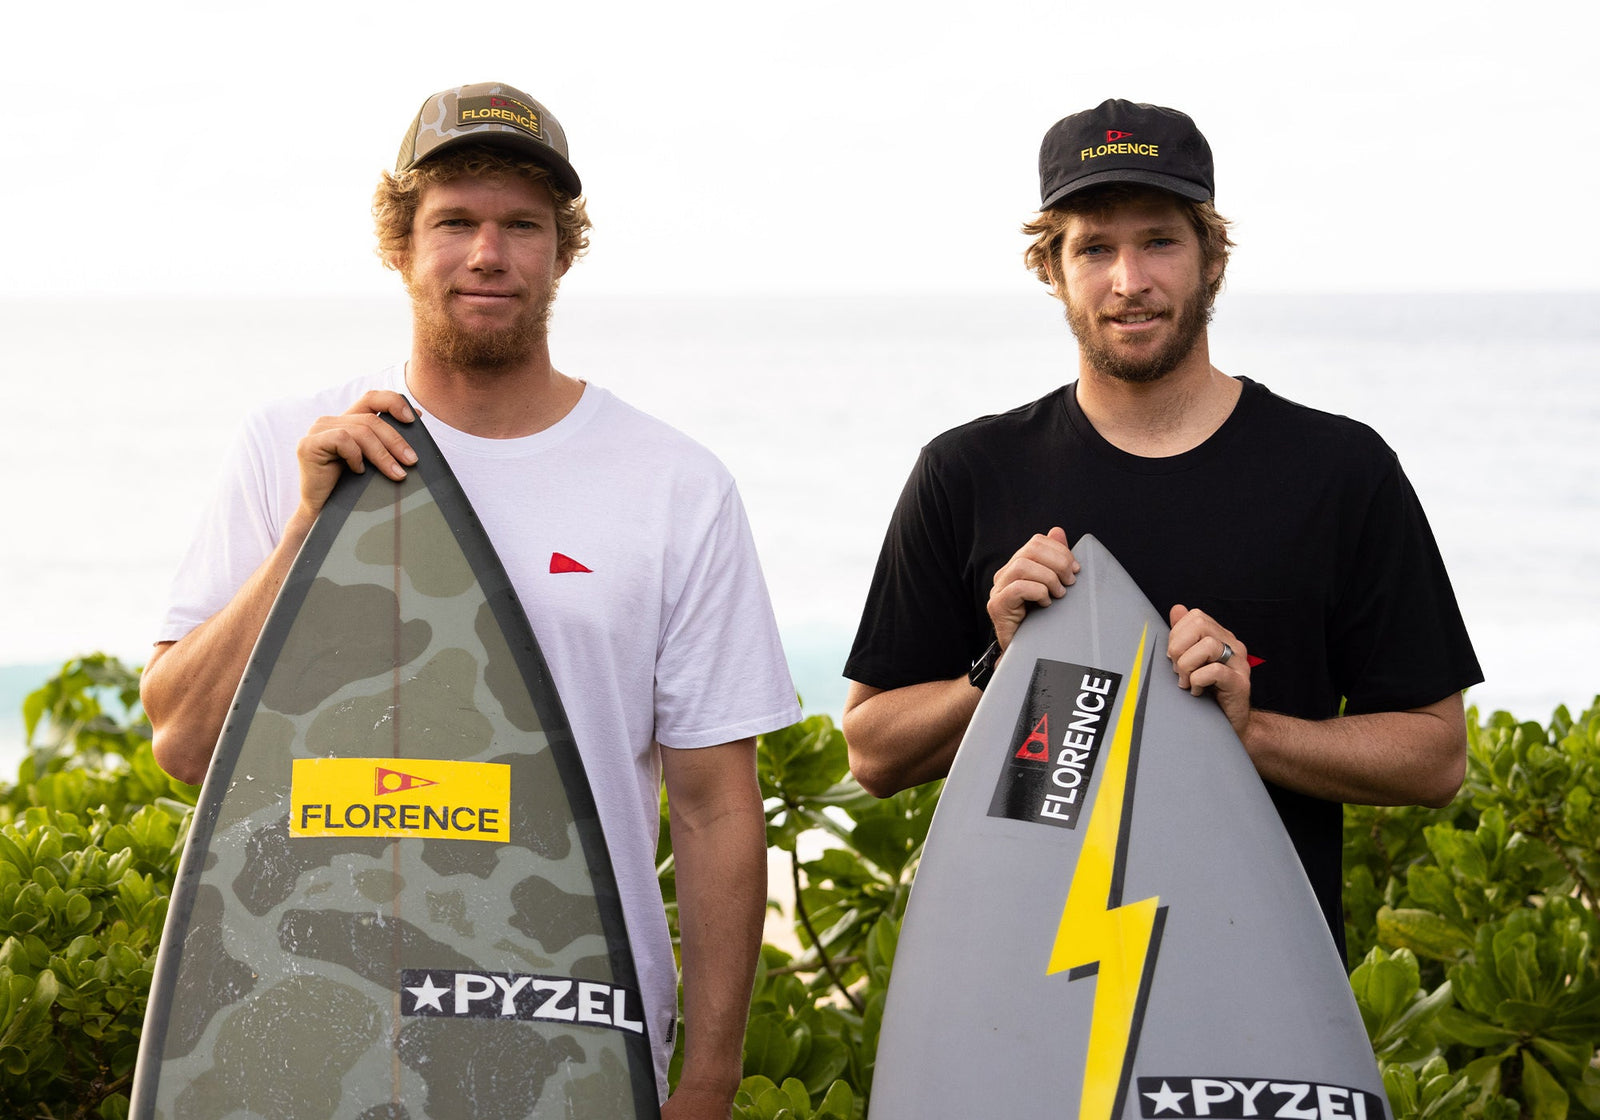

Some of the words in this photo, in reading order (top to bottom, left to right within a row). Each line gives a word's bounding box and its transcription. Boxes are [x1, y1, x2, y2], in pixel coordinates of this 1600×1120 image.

[462, 108, 539, 133] FLORENCE
[1080, 143, 1159, 161] FLORENCE
[1040, 674, 1112, 821] FLORENCE
[301, 804, 499, 833] FLORENCE
[454, 973, 644, 1034] PYZEL
